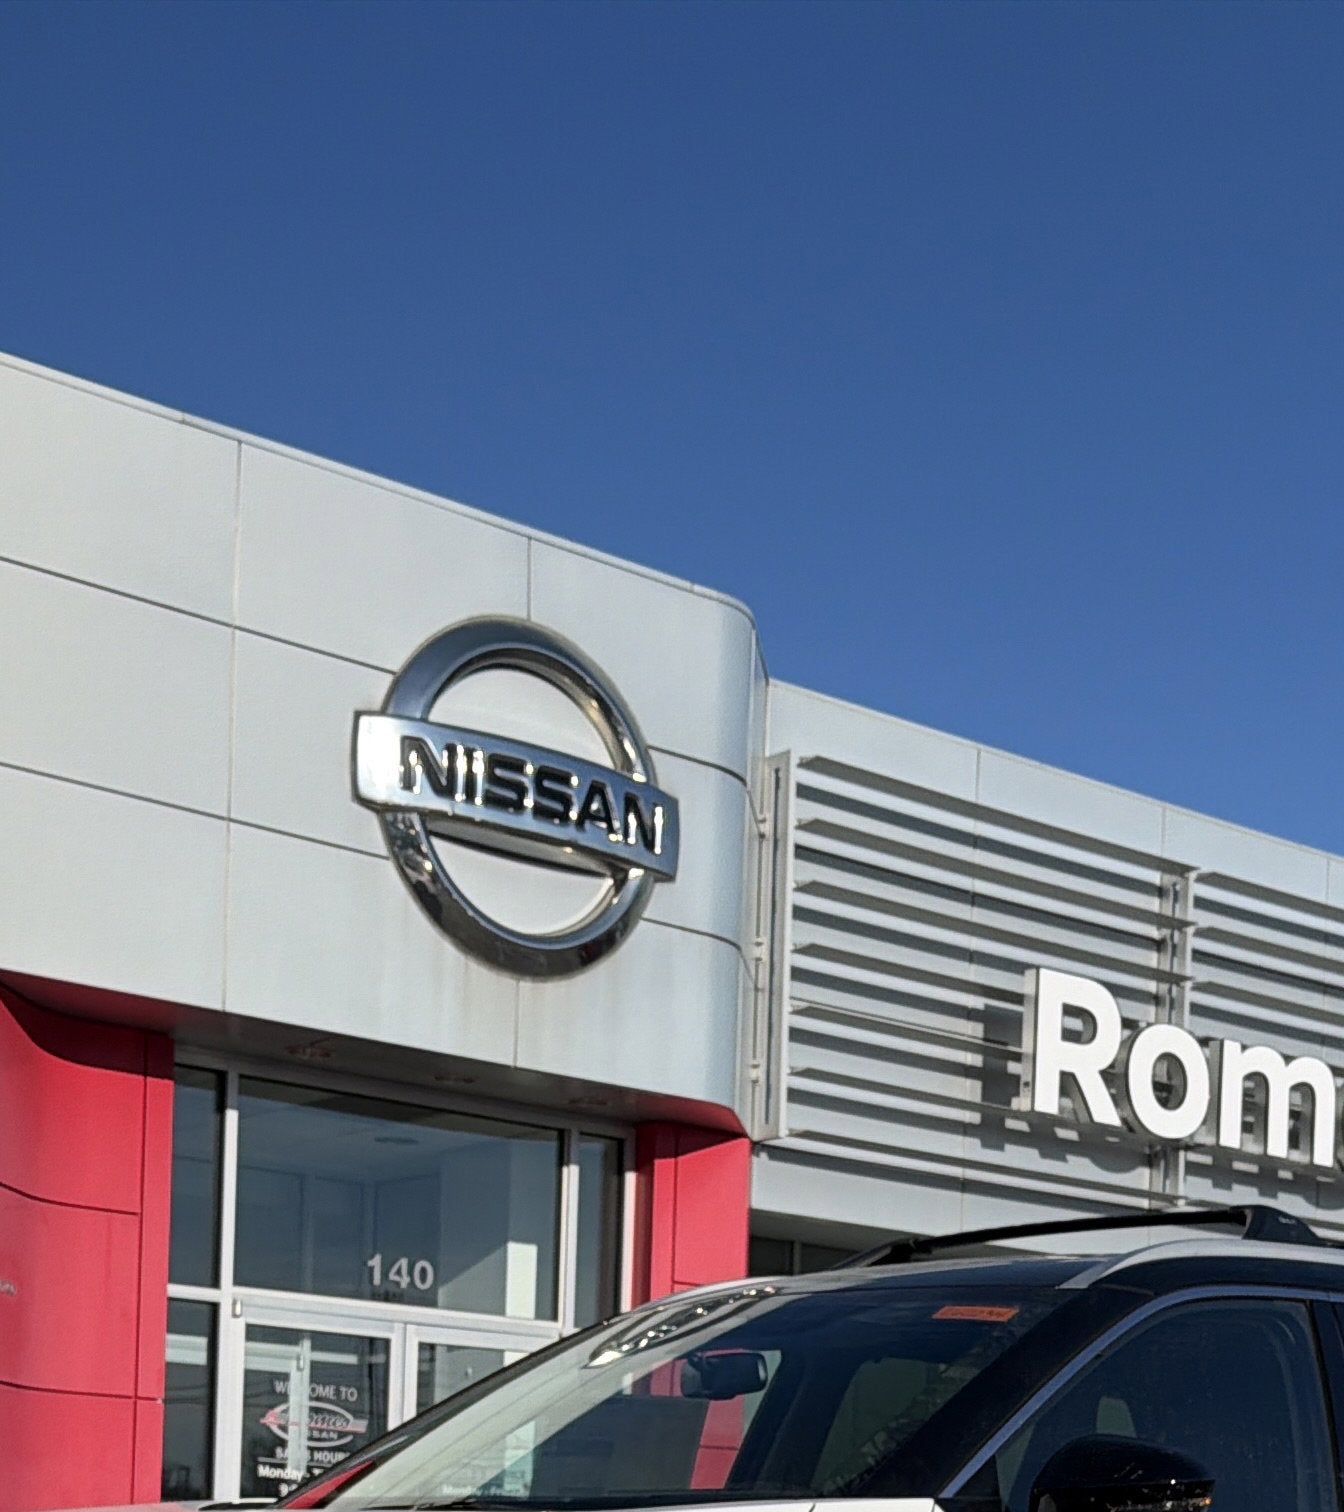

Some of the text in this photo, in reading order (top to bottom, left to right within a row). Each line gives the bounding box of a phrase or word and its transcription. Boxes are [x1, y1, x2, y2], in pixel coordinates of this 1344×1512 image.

[399, 735, 665, 856] NISSAN
[367, 1253, 434, 1290] 140
[340, 1386, 358, 1401] TO
[257, 1464, 303, 1482] Monday
